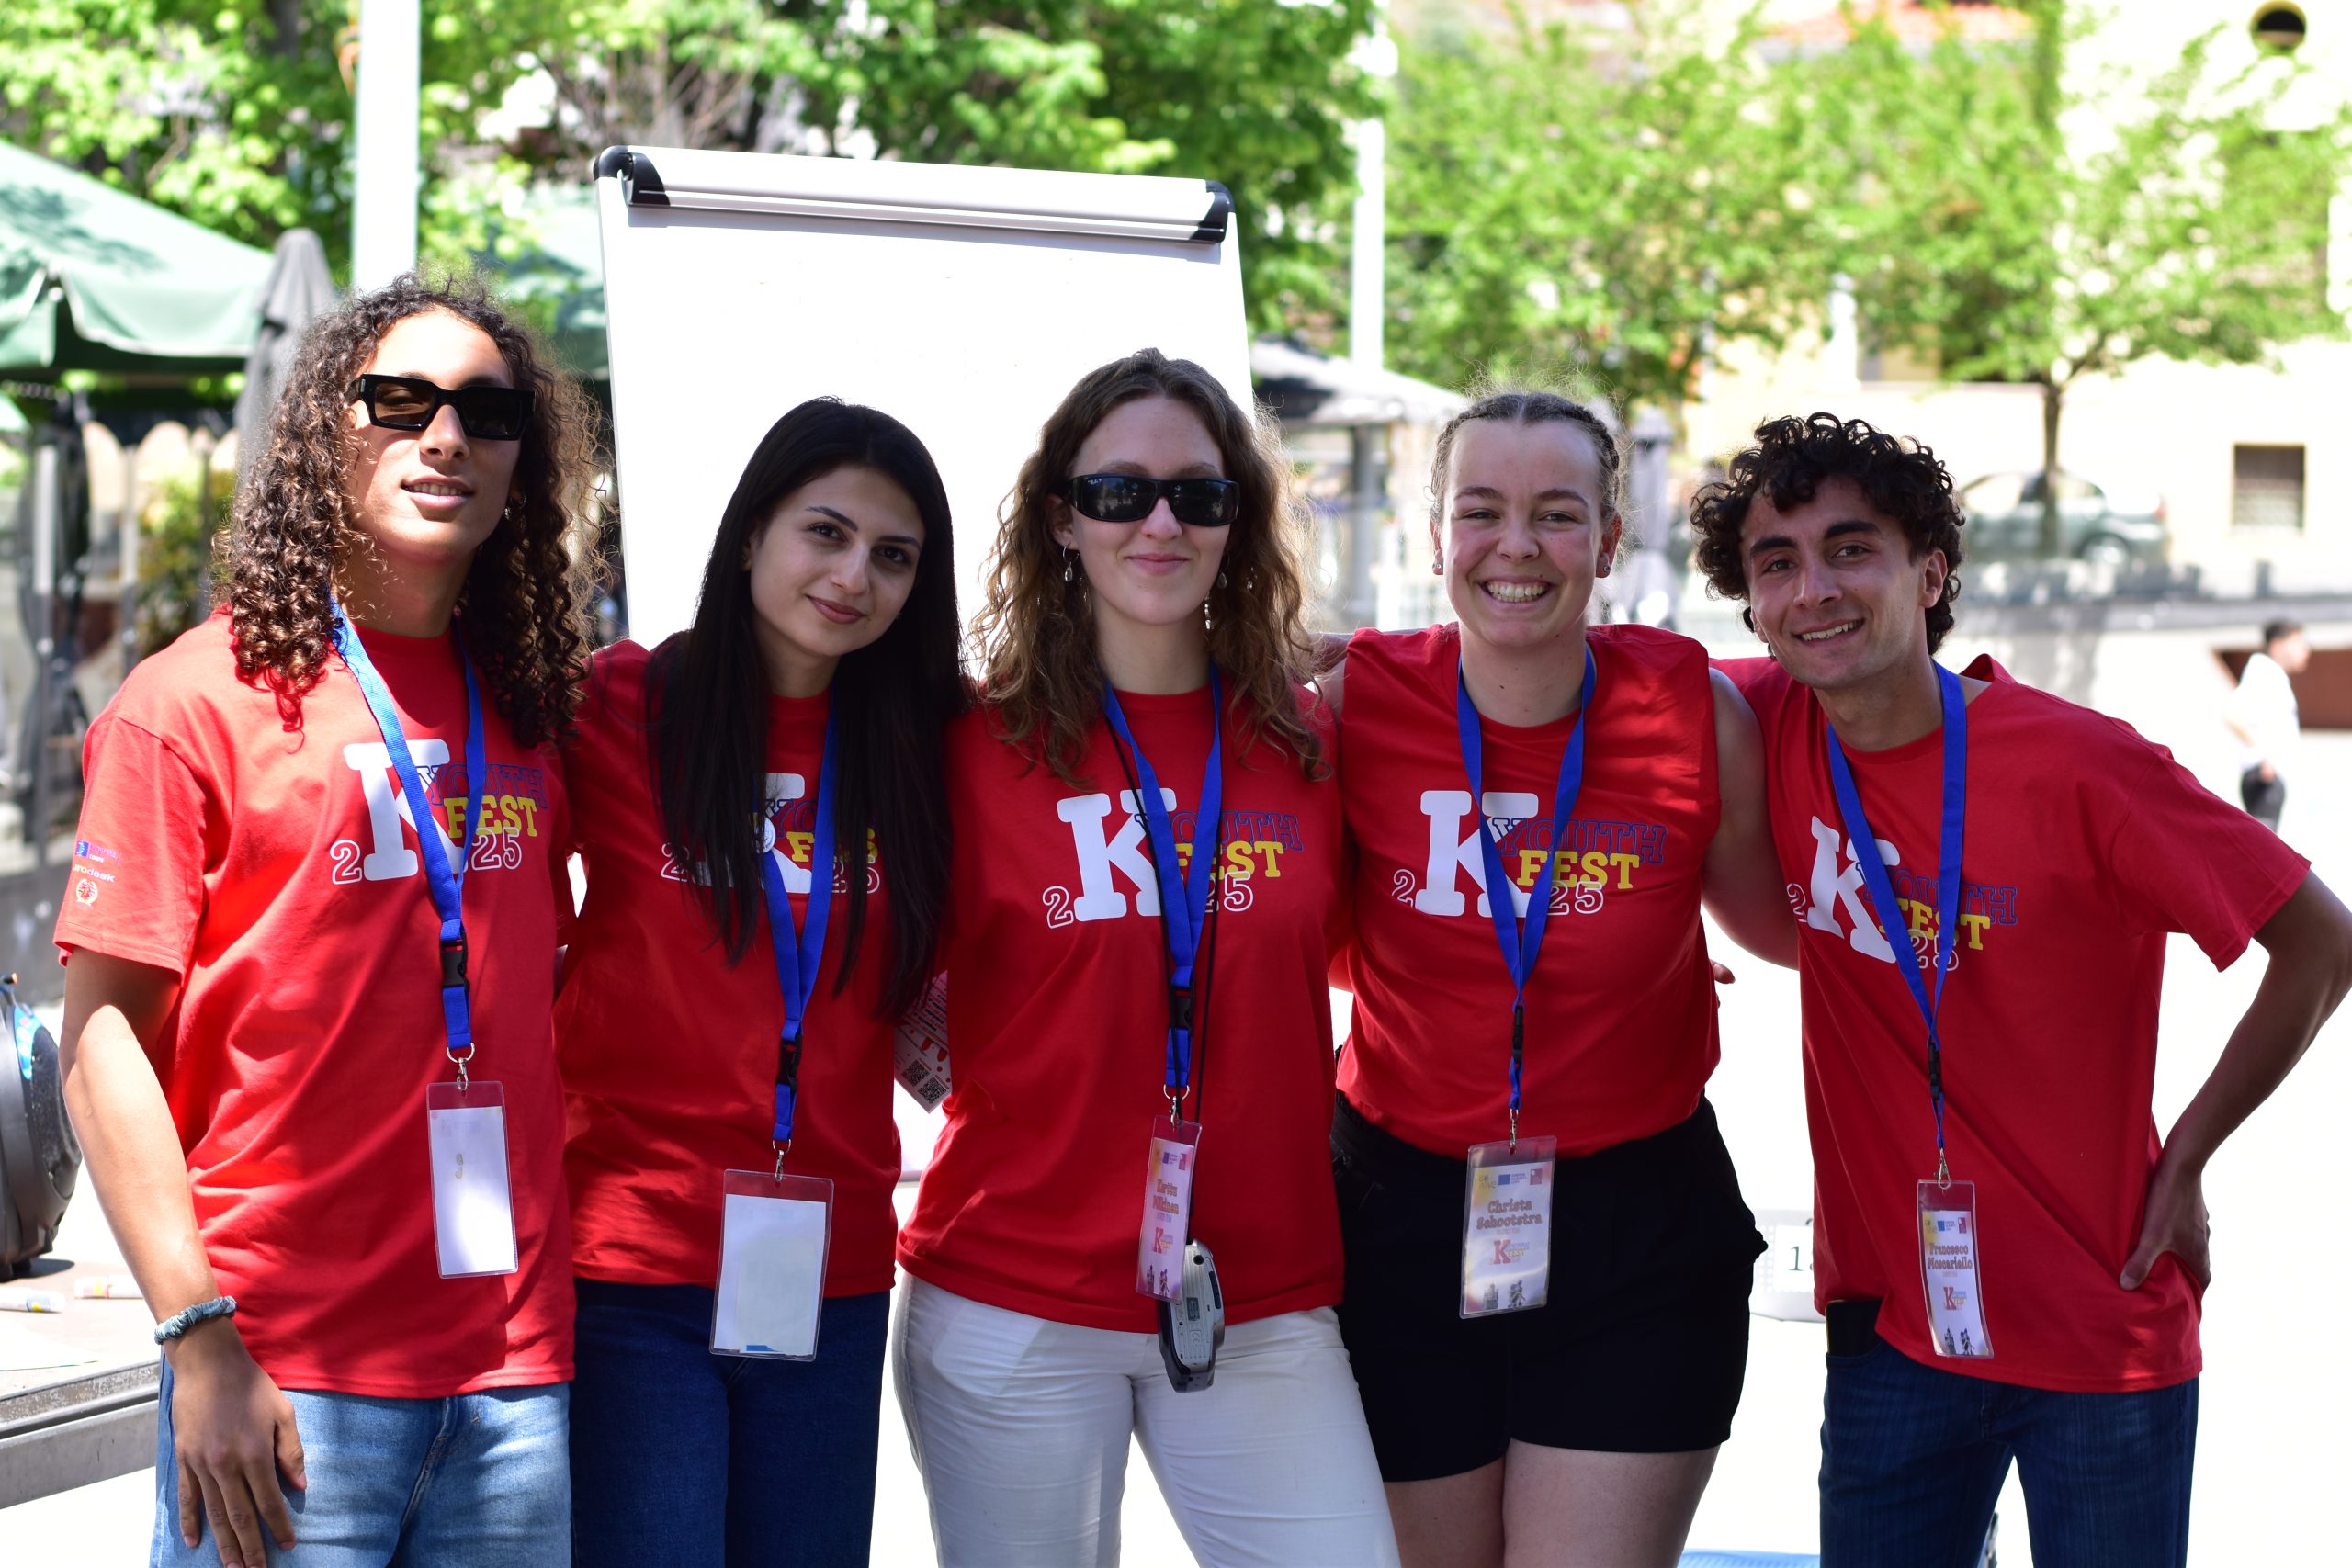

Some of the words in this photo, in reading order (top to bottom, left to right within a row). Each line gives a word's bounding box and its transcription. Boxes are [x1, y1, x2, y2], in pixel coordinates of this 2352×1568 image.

[343, 739, 469, 881] K
[444, 795, 537, 838] FEST
[1057, 787, 1177, 921] K
[1415, 790, 1539, 918] K
[1516, 850, 1640, 889] FEST
[1487, 1198, 1532, 1213] Christa
